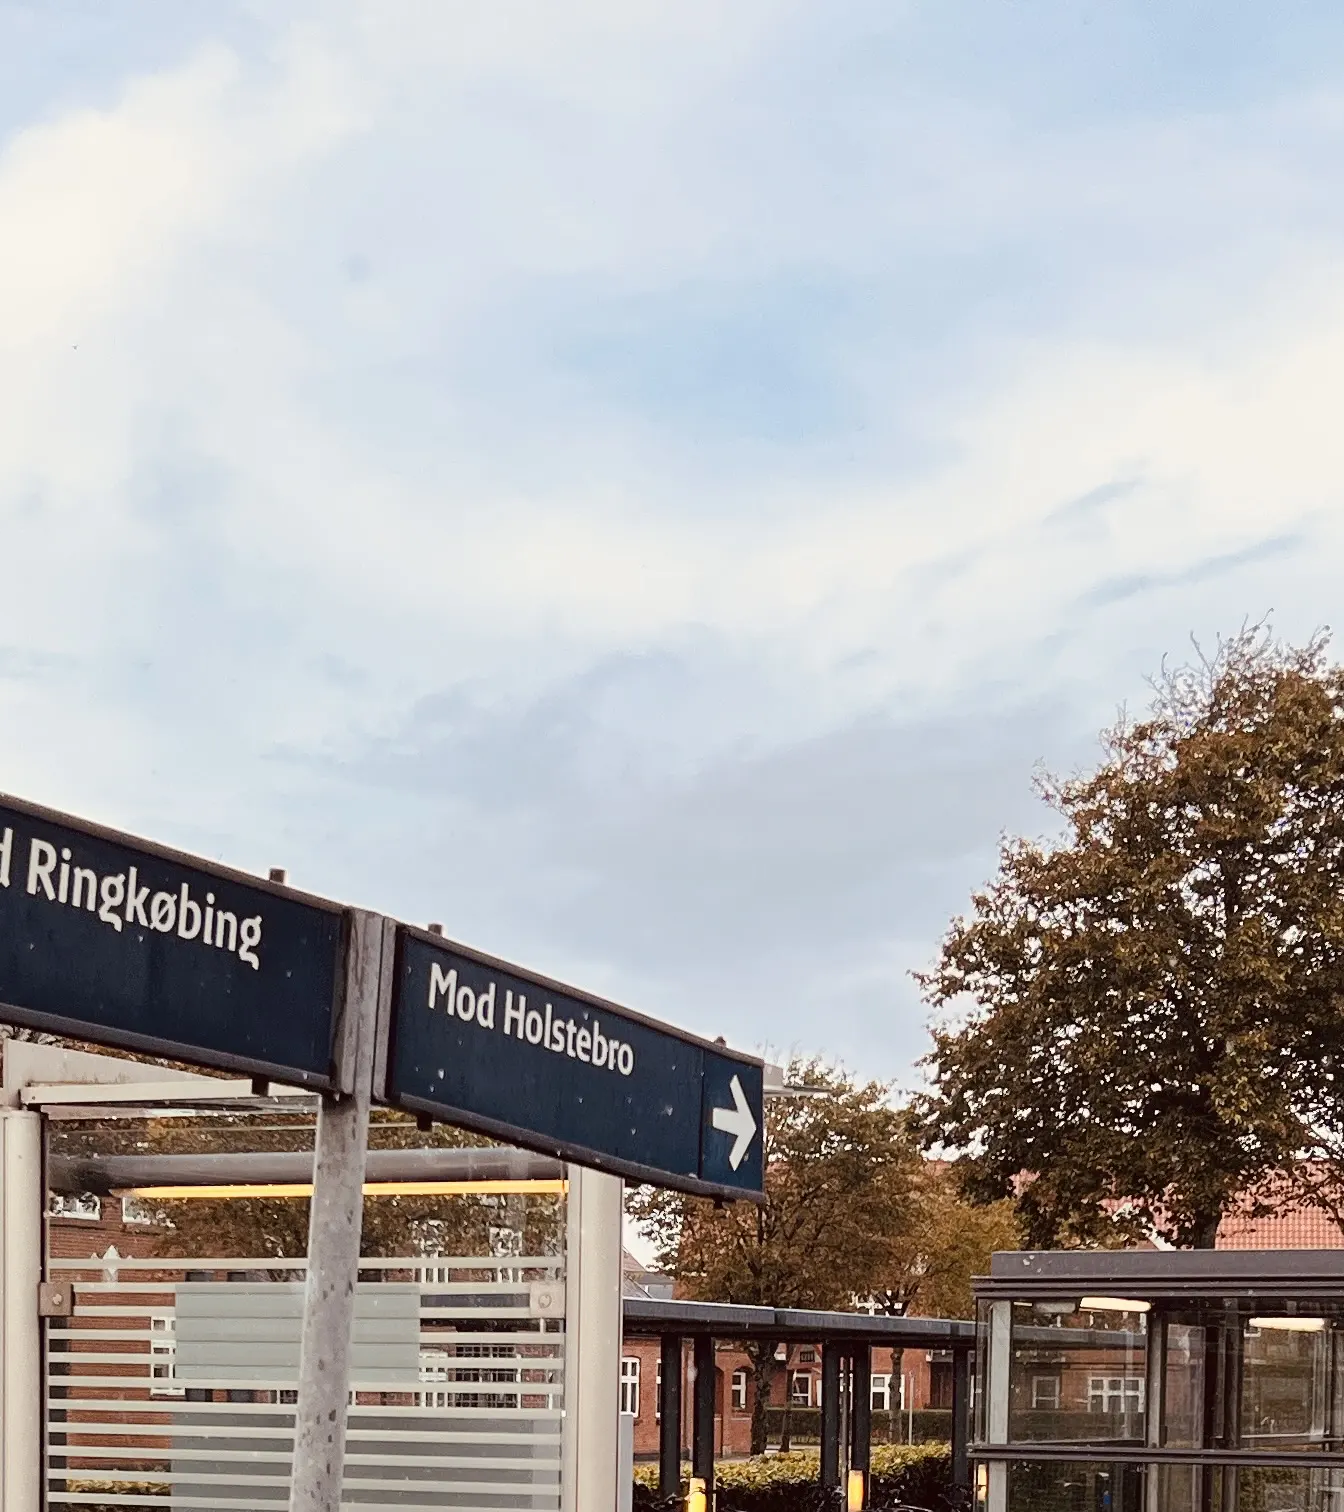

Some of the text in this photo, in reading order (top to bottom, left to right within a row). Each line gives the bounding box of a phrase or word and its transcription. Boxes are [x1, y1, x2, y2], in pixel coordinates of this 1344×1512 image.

[26, 838, 263, 970] Ringkøbing
[428, 962, 635, 1076] Mod Holstebro
